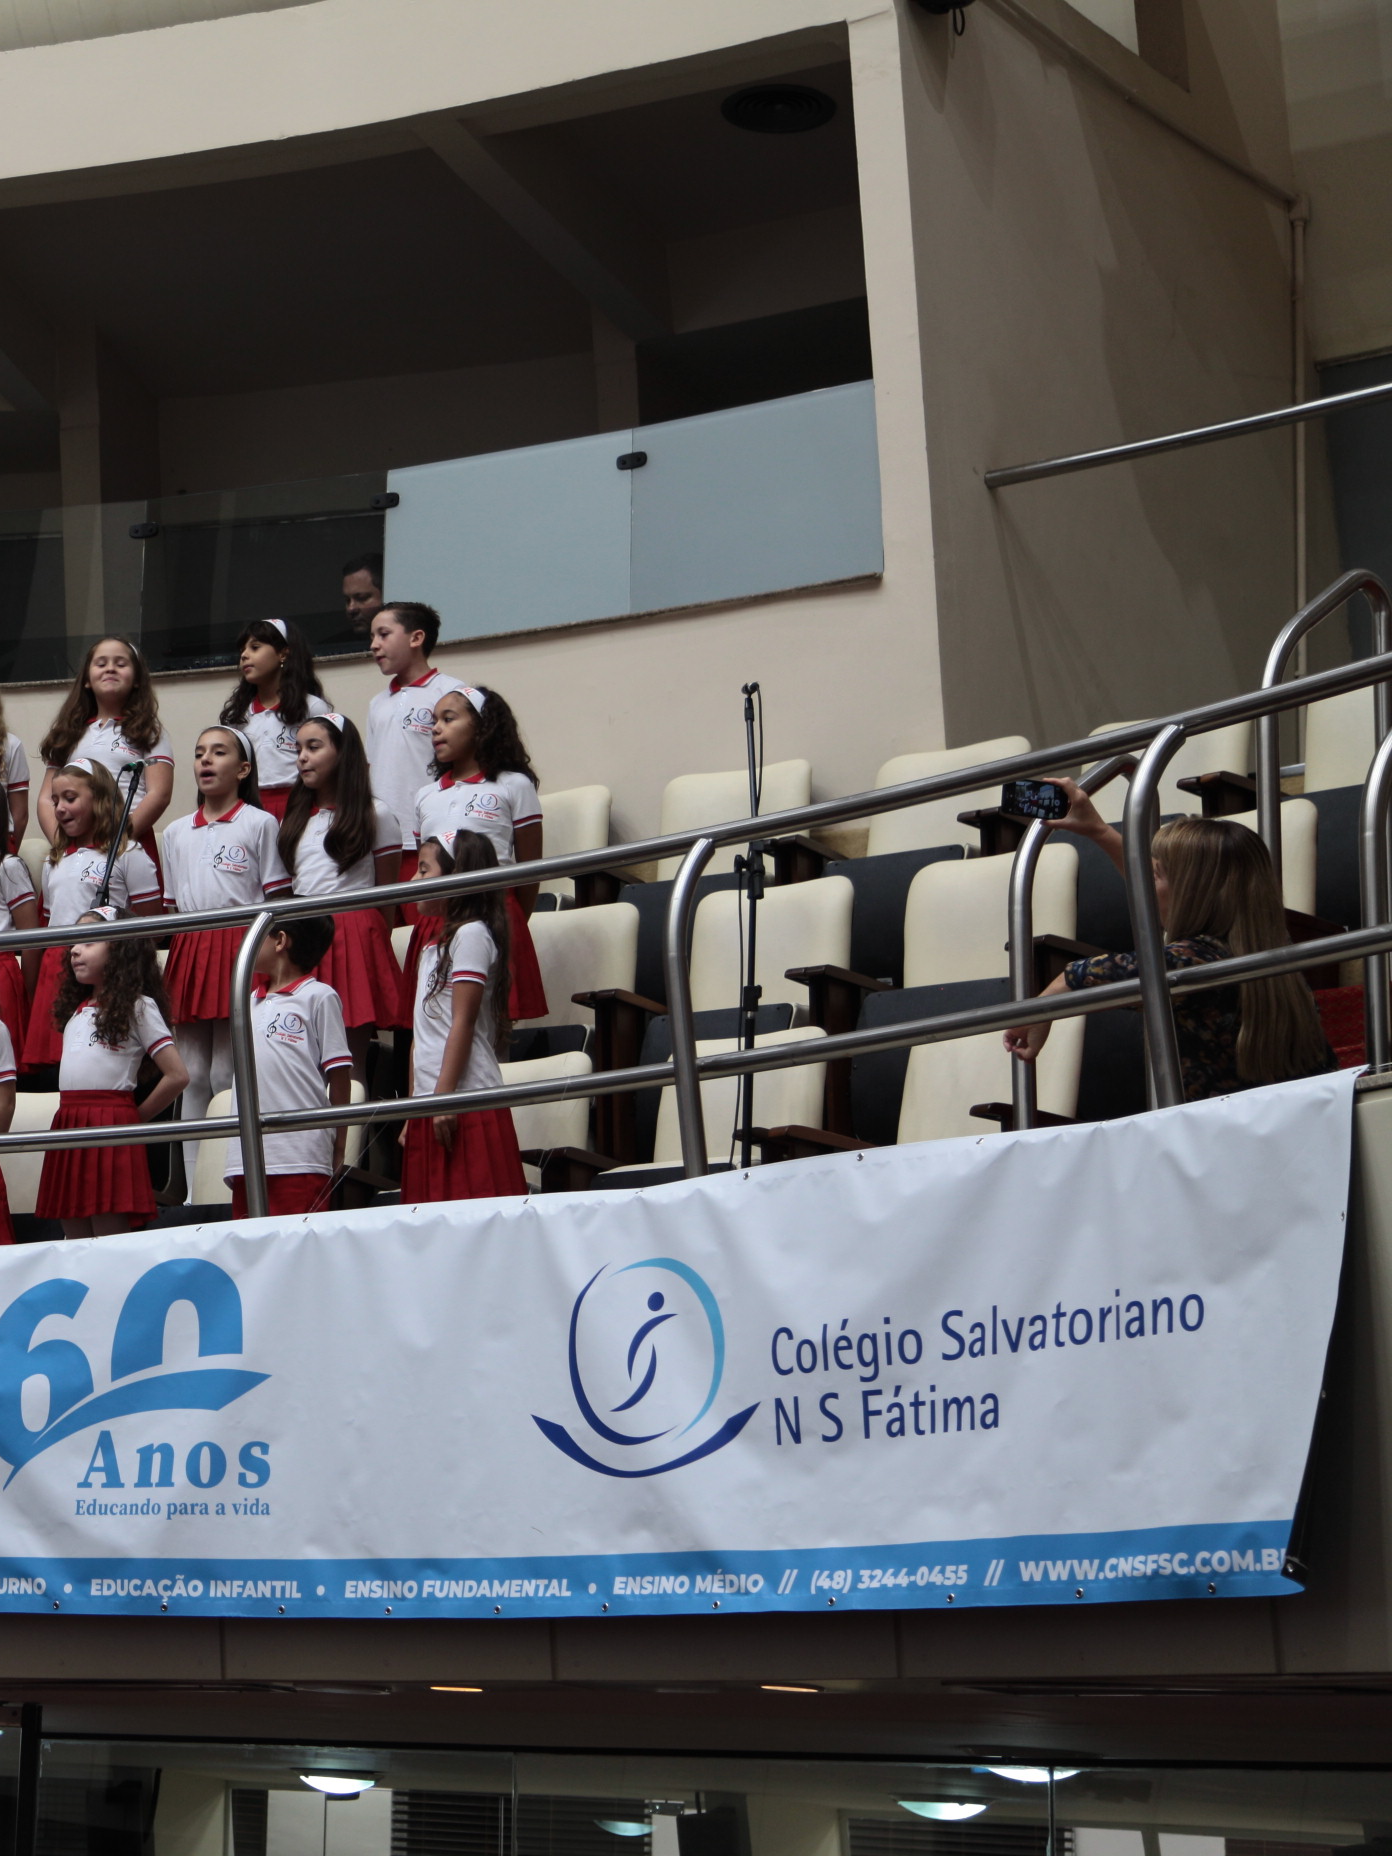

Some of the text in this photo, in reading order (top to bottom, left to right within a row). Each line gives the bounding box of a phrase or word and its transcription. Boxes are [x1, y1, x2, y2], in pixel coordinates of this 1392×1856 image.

[771, 1288, 1205, 1383] Colégio Salvatoriano
[774, 1384, 1000, 1446] N S Fátima
[76, 1430, 271, 1490] Anos
[75, 1497, 270, 1521] Educando para a vida
[90, 1574, 204, 1602] EDUCAÇÃO
[209, 1580, 302, 1599] INFANTIL
[344, 1580, 418, 1599] ENSINO
[422, 1579, 572, 1599] FUNDAMENTAL
[613, 1575, 690, 1595] ENSINO
[694, 1568, 764, 1594] MÉDIO
[810, 1568, 852, 1594] (48)
[857, 1565, 968, 1589] 3244-0455
